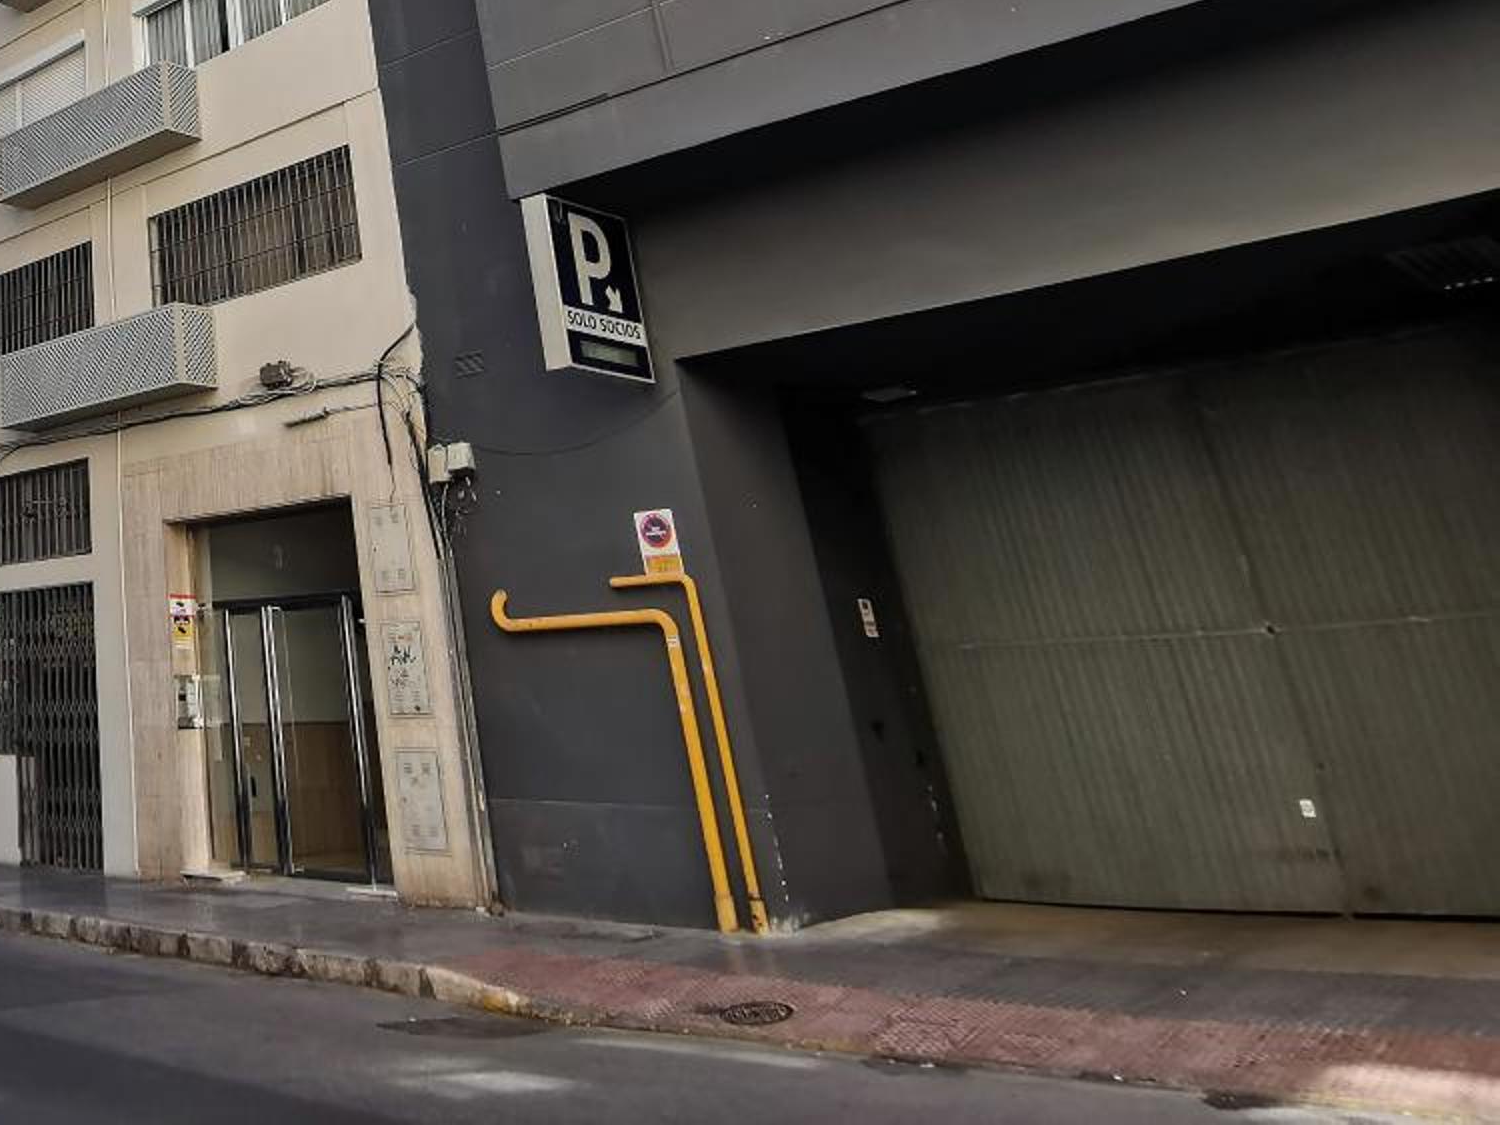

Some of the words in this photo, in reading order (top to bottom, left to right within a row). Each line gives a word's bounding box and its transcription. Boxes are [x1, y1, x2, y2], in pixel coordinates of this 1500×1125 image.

[566, 211, 612, 306] P
[566, 309, 598, 331] SOLO
[599, 317, 642, 340] SOCIOS
